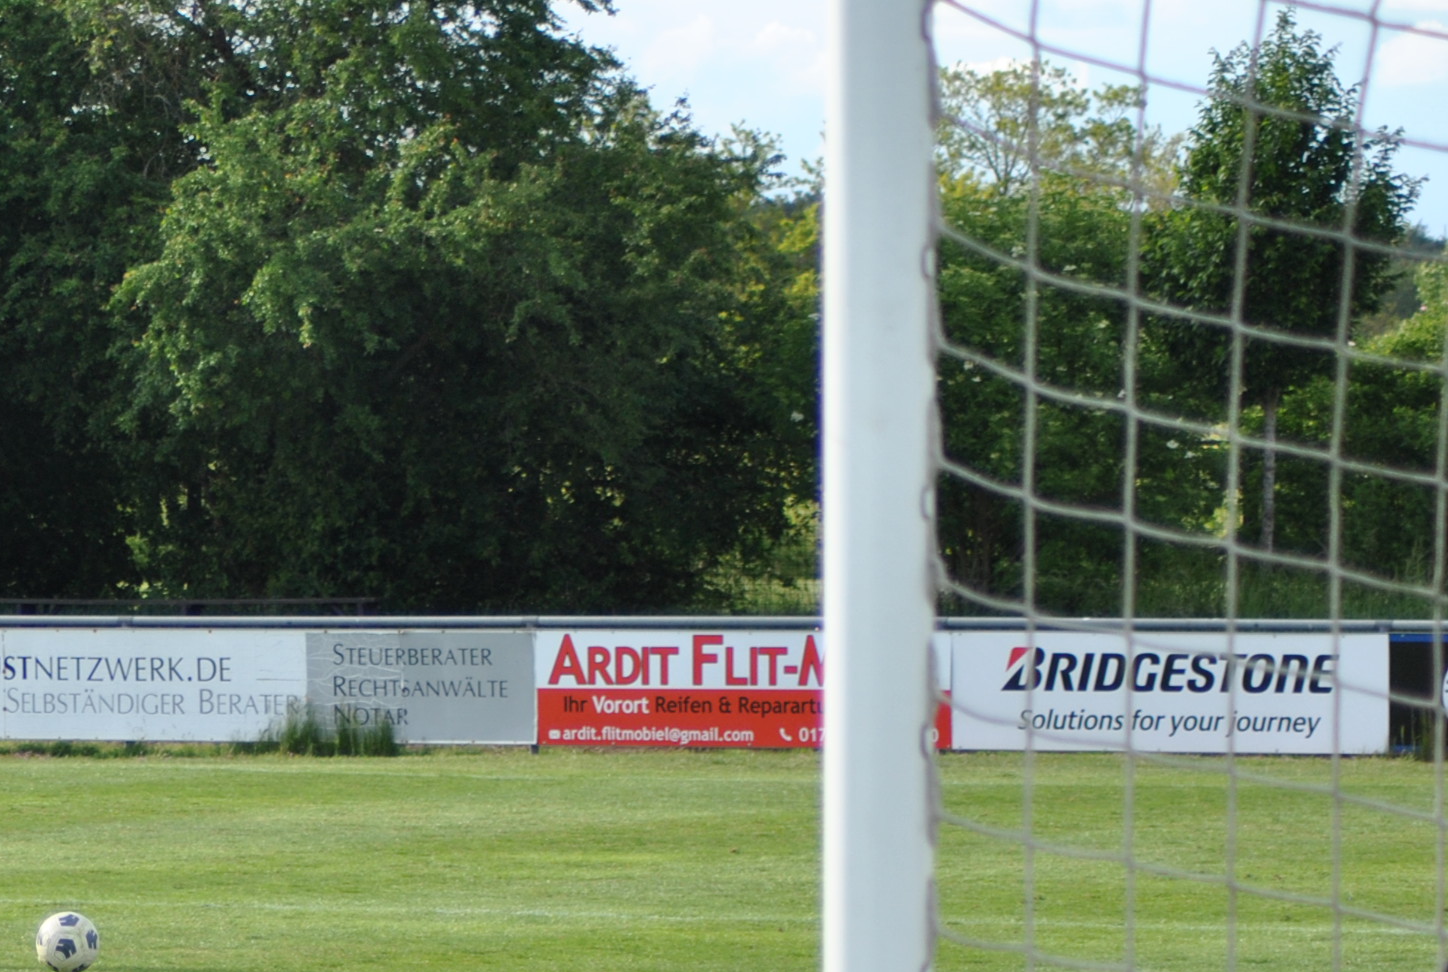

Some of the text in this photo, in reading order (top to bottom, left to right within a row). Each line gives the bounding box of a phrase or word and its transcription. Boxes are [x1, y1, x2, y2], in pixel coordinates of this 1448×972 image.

[1001, 646, 1339, 694] BRIDGESTONE
[563, 696, 588, 713] Ihr
[592, 695, 650, 714] Vorort
[655, 696, 713, 714] Reifen
[718, 697, 732, 714] &
[562, 726, 754, 744] ardit.flitmobiel@gmail.com
[1017, 709, 1322, 738] Solutions for your journey
